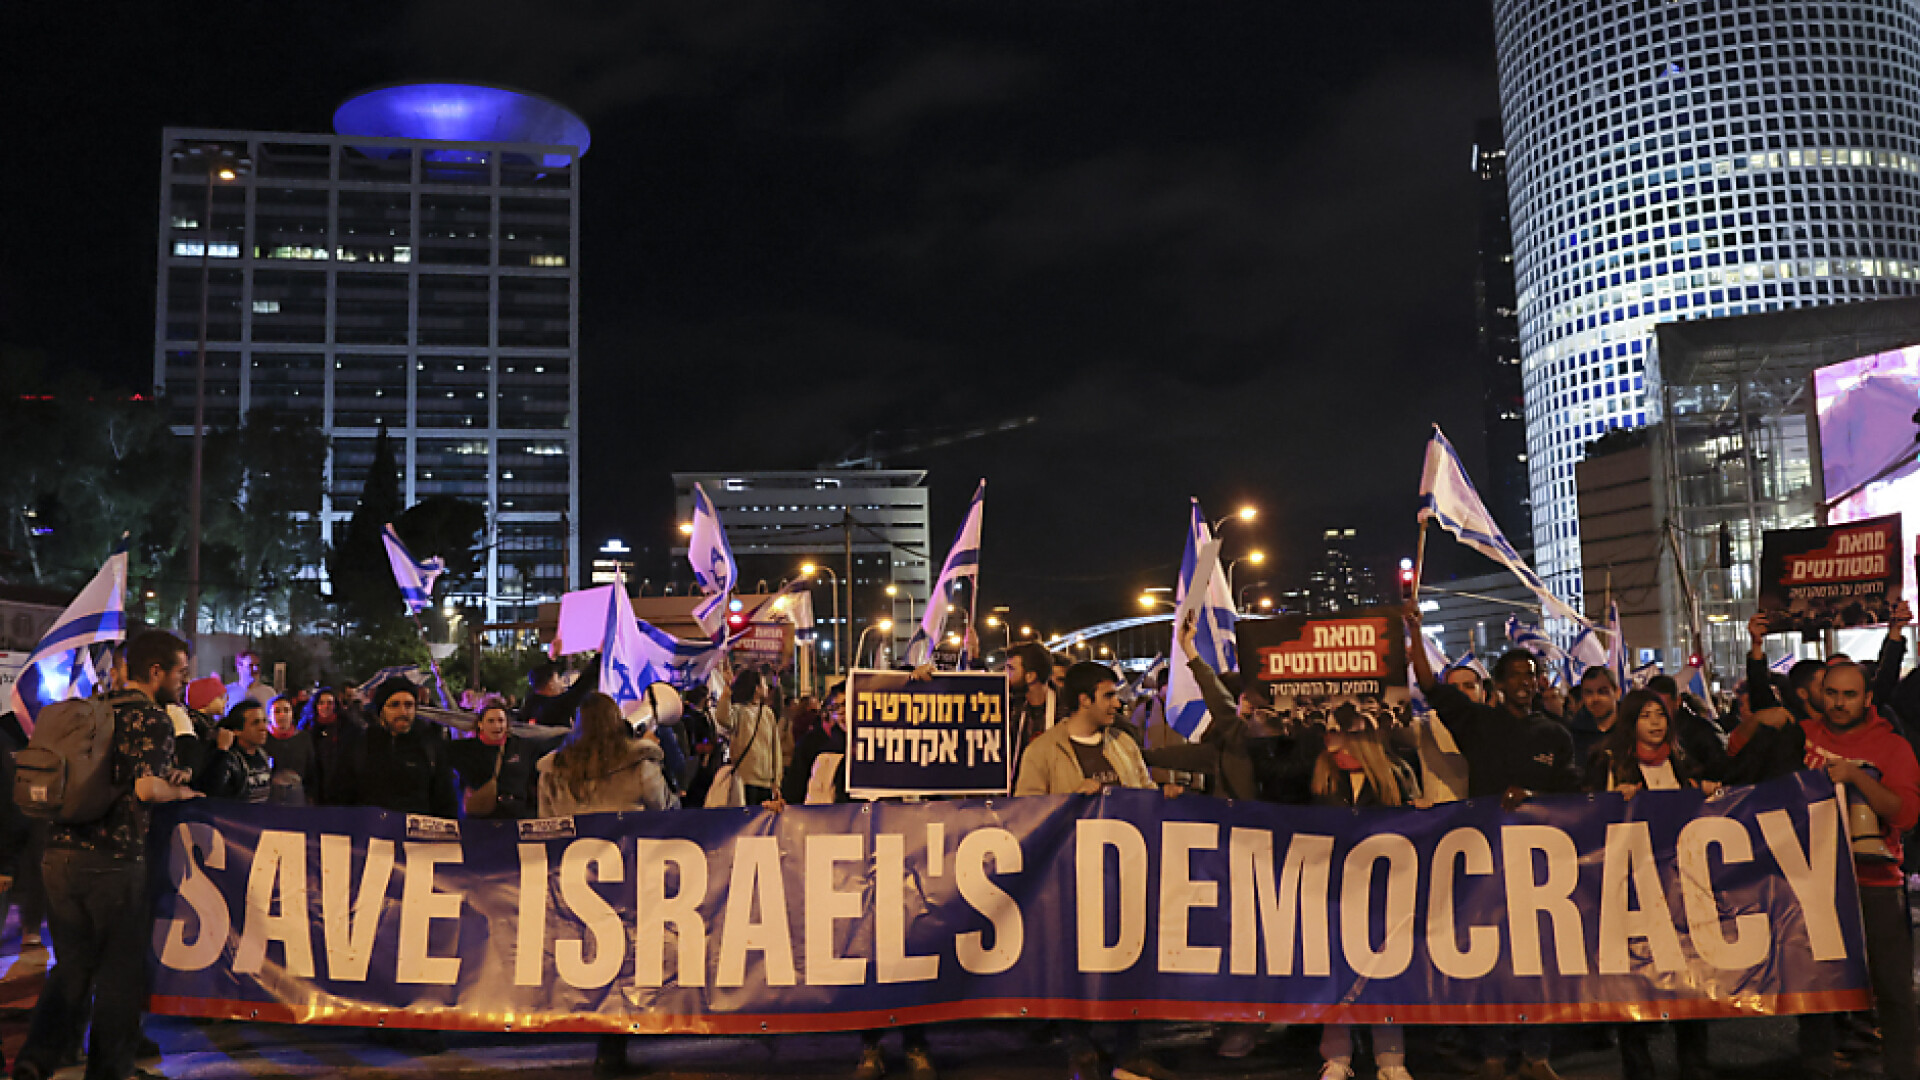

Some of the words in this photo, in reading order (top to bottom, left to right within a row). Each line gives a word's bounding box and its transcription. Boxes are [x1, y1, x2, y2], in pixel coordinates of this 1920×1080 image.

[1836, 530, 1885, 554] מחאת
[1792, 554, 1885, 579] הסטודנטים
[1313, 624, 1376, 648] מחאת
[1269, 650, 1378, 674] הסטודנטים
[857, 692, 967, 726] דמוקרטיה
[970, 692, 1002, 724] בלי
[856, 727, 959, 768] אקדמיה
[965, 729, 1002, 768] אין
[153, 822, 464, 984] SAVE
[514, 822, 1024, 990] ISRAEL'S
[1076, 799, 1847, 980] DEMOCRACY
